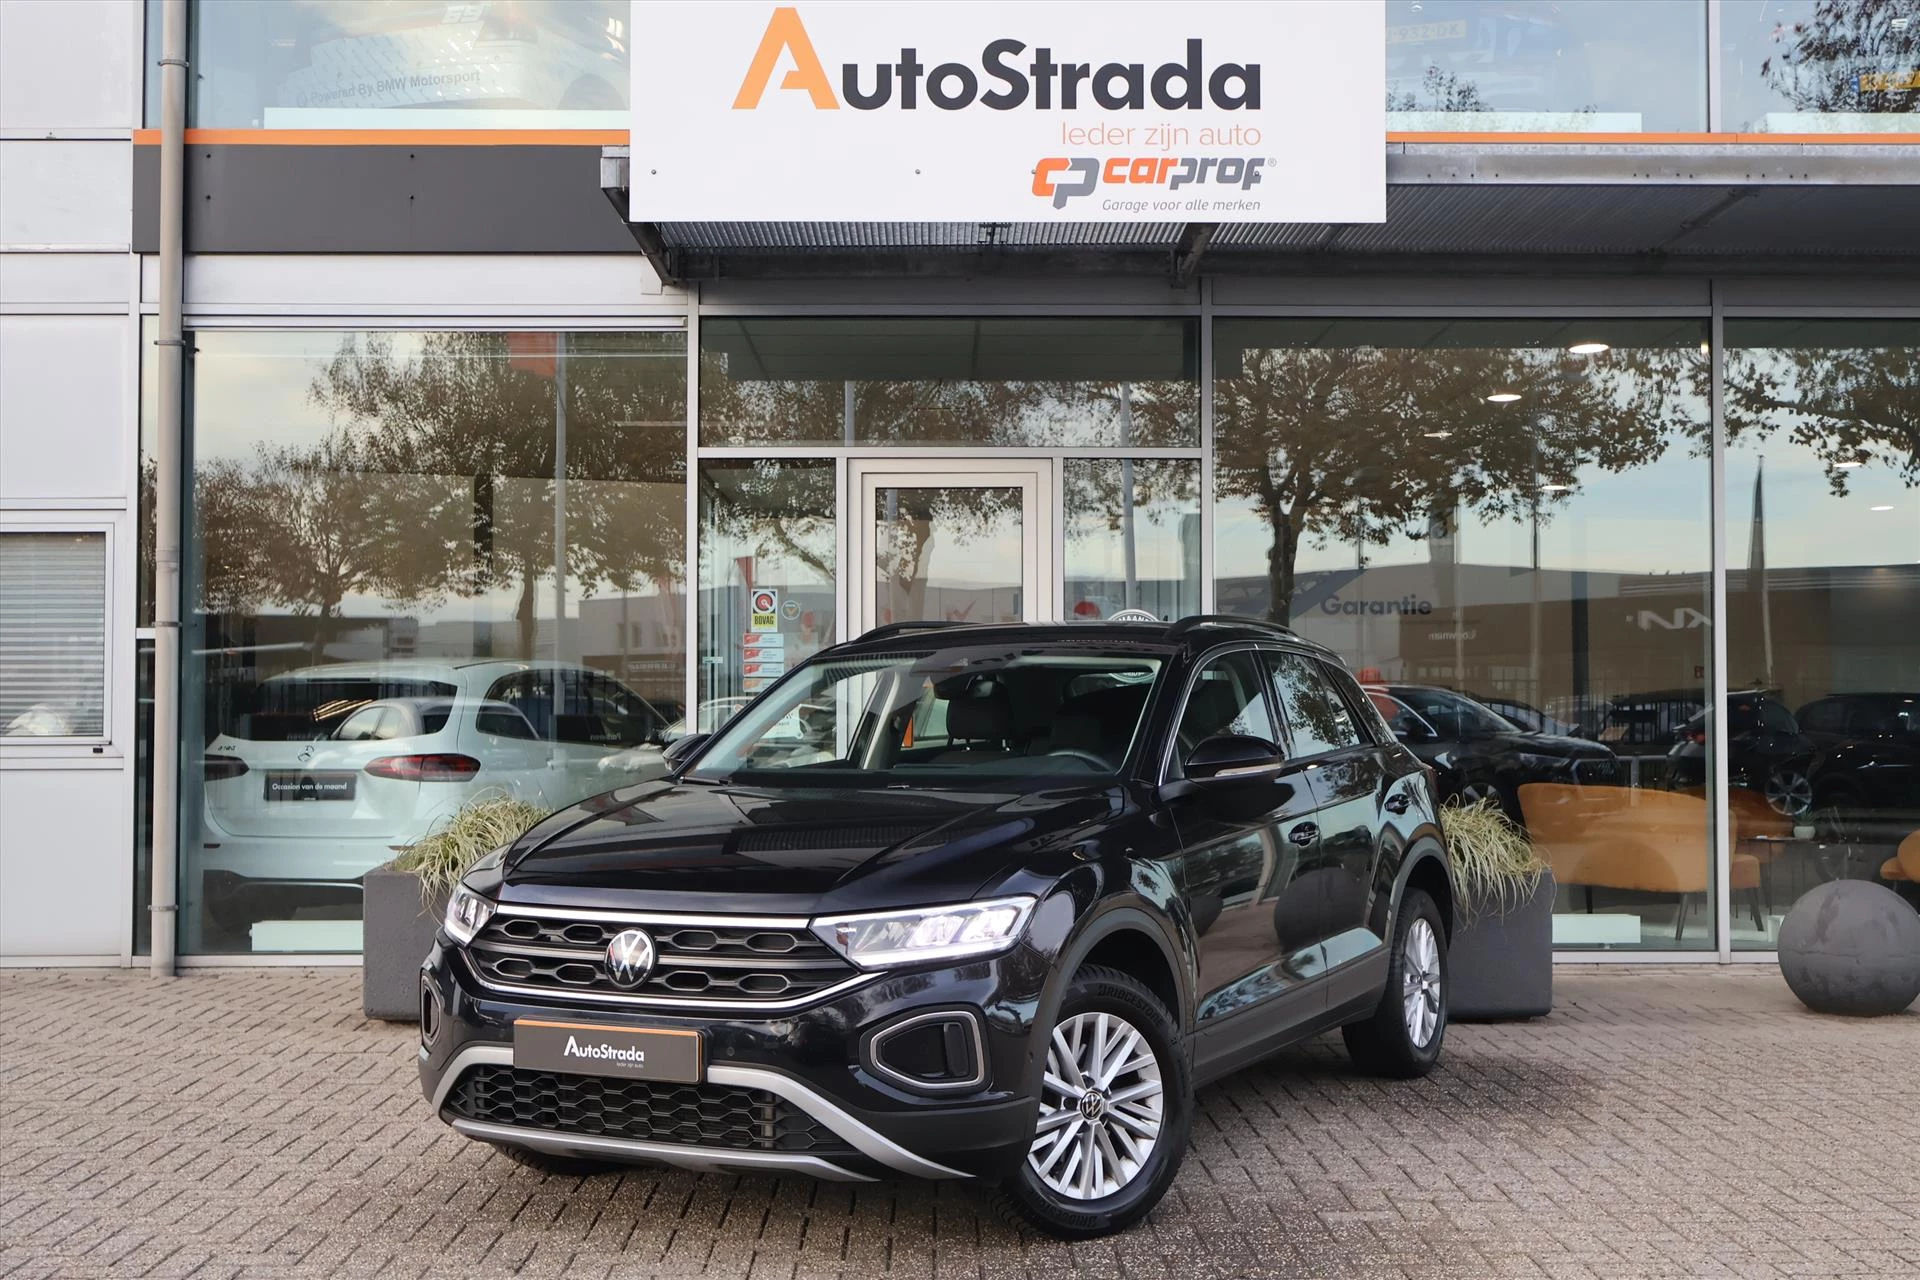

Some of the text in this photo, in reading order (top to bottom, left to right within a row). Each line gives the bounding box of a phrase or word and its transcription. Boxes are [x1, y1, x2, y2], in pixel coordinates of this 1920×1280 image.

[732, 7, 1261, 111] AutoStrada
[358, 83, 373, 97] By
[376, 77, 406, 93] BMW
[410, 69, 481, 90] Motorsport
[1062, 122, 1262, 151] Ieder zijn auto
[1102, 199, 1261, 214] Garage voor alle merken
[1320, 594, 1432, 616] Garantie
[754, 615, 774, 625] BOVAG
[271, 783, 301, 791] Occasion
[314, 783, 324, 791] de
[323, 783, 347, 791] maand
[563, 1035, 645, 1062] AutoStrada
